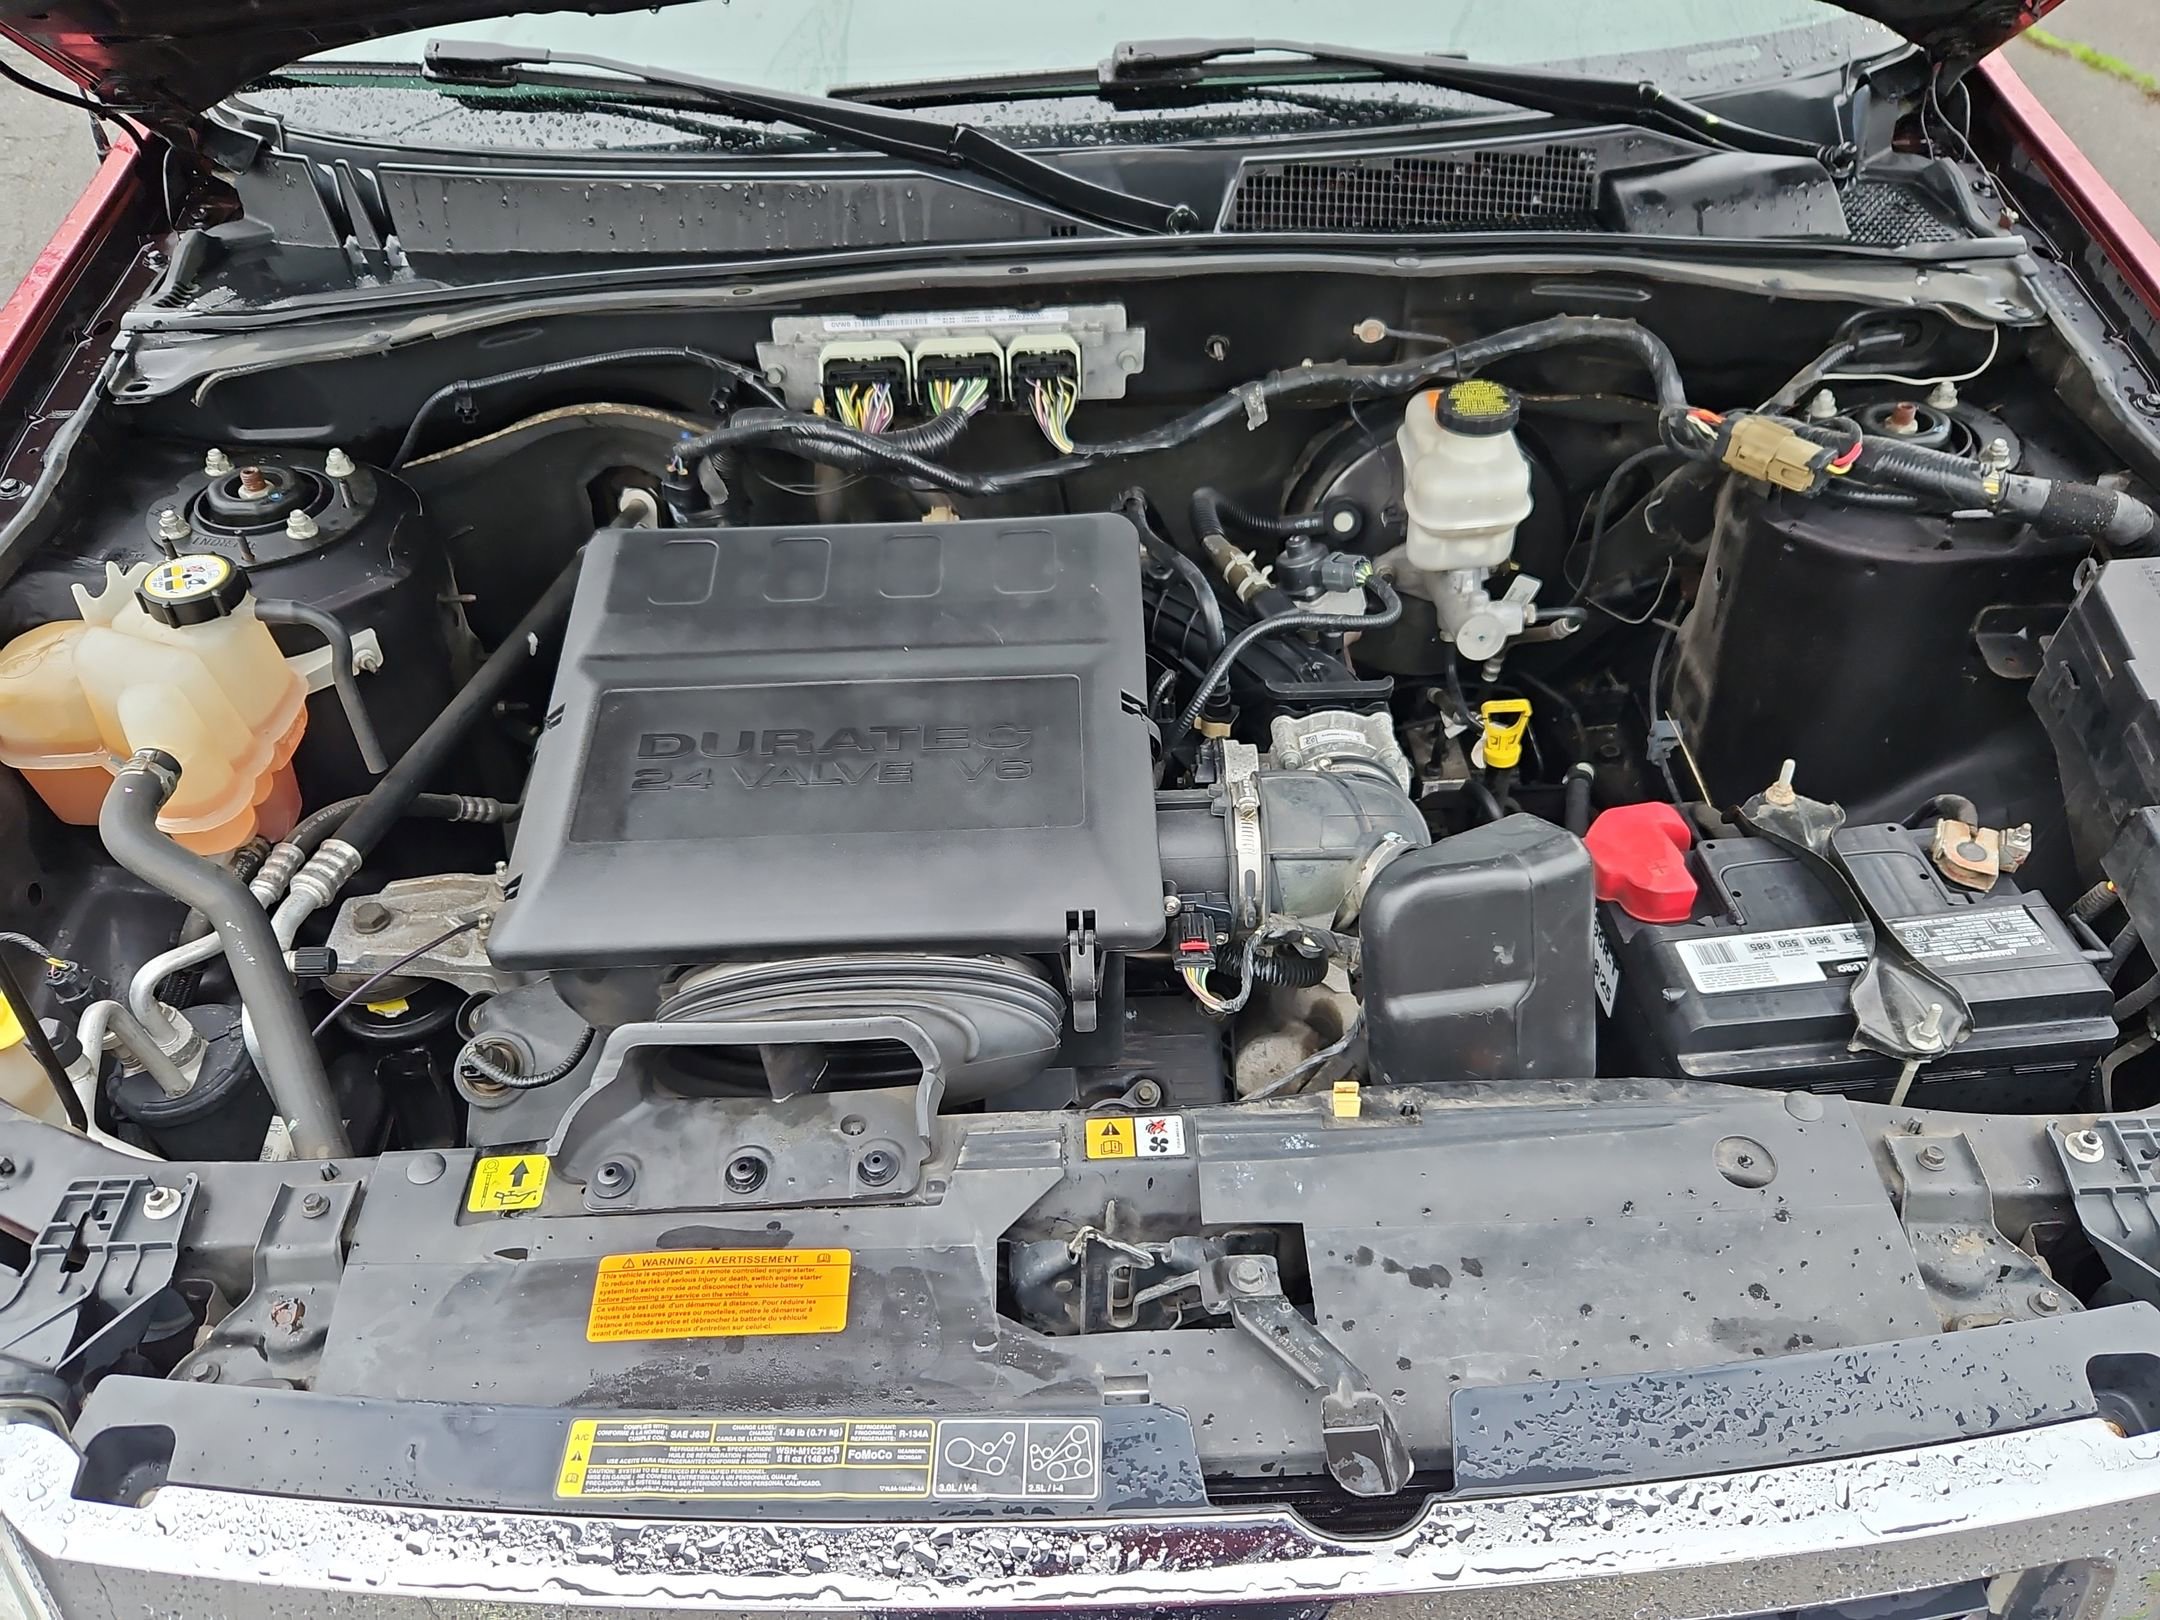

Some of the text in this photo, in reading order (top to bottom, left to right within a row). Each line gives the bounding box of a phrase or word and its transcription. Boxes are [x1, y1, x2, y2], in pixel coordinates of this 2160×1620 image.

[636, 723, 1033, 759] DURATEC
[631, 758, 1033, 792] 24 VALVE V6
[1808, 936, 1831, 945] 96R
[1842, 932, 1862, 942] R-T
[1750, 942, 1771, 952] 685
[1778, 940, 1799, 948] 550
[642, 1257, 697, 1266] WARNING:
[707, 1256, 799, 1264] AVERTISSEMENT
[670, 1430, 710, 1438] SAE J639
[807, 1428, 827, 1437] (0.71
[829, 1428, 843, 1436] kg)
[899, 1430, 928, 1438] R-134A
[848, 1449, 892, 1460] FoMoCo
[939, 1484, 957, 1492] 3.0L
